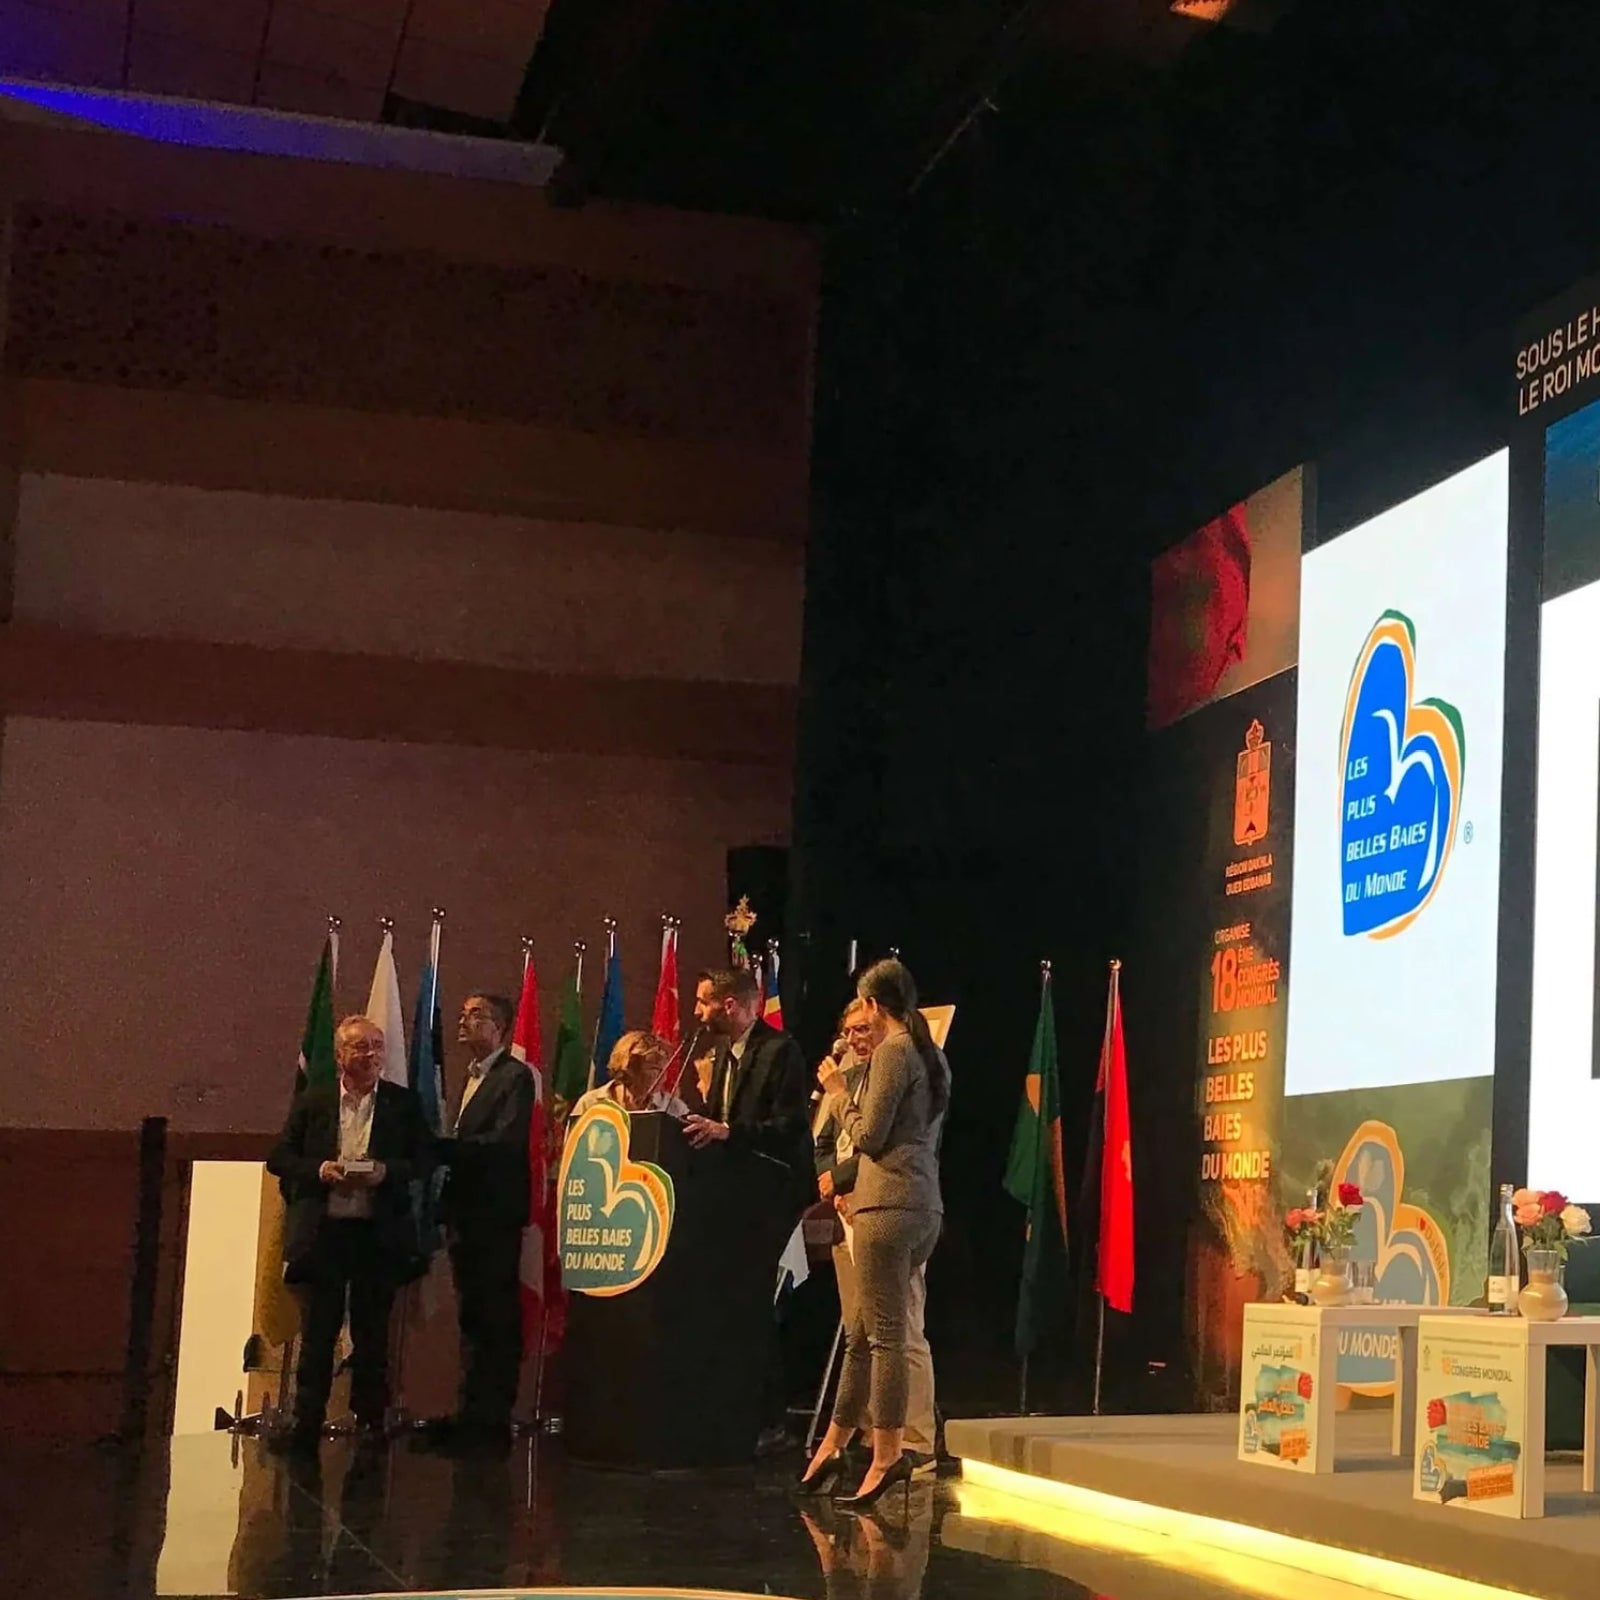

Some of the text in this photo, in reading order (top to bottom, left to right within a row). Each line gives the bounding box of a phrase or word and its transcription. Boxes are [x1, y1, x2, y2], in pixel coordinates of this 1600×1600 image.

[1516, 329, 1563, 379] SOUS
[1567, 312, 1589, 351] LE
[1519, 379, 1540, 416] LE
[1543, 361, 1571, 402] ROI
[1347, 756, 1368, 781] LES
[1346, 794, 1376, 822] PLUS
[1346, 821, 1427, 862] BELLES BAIES
[1345, 870, 1407, 903] DU MONDE
[1211, 948, 1237, 1013] 18
[1236, 984, 1277, 1009] MONDIAL
[1208, 1030, 1267, 1065] LES PLUS
[1206, 1072, 1254, 1102] BELLES
[1203, 1112, 1242, 1142] BAIES
[1202, 1150, 1270, 1180] DU MONDE
[567, 1178, 585, 1196] LES
[567, 1203, 592, 1221] PLUS
[566, 1228, 632, 1247] BELLES BAIES
[565, 1252, 625, 1271] DU MONDE
